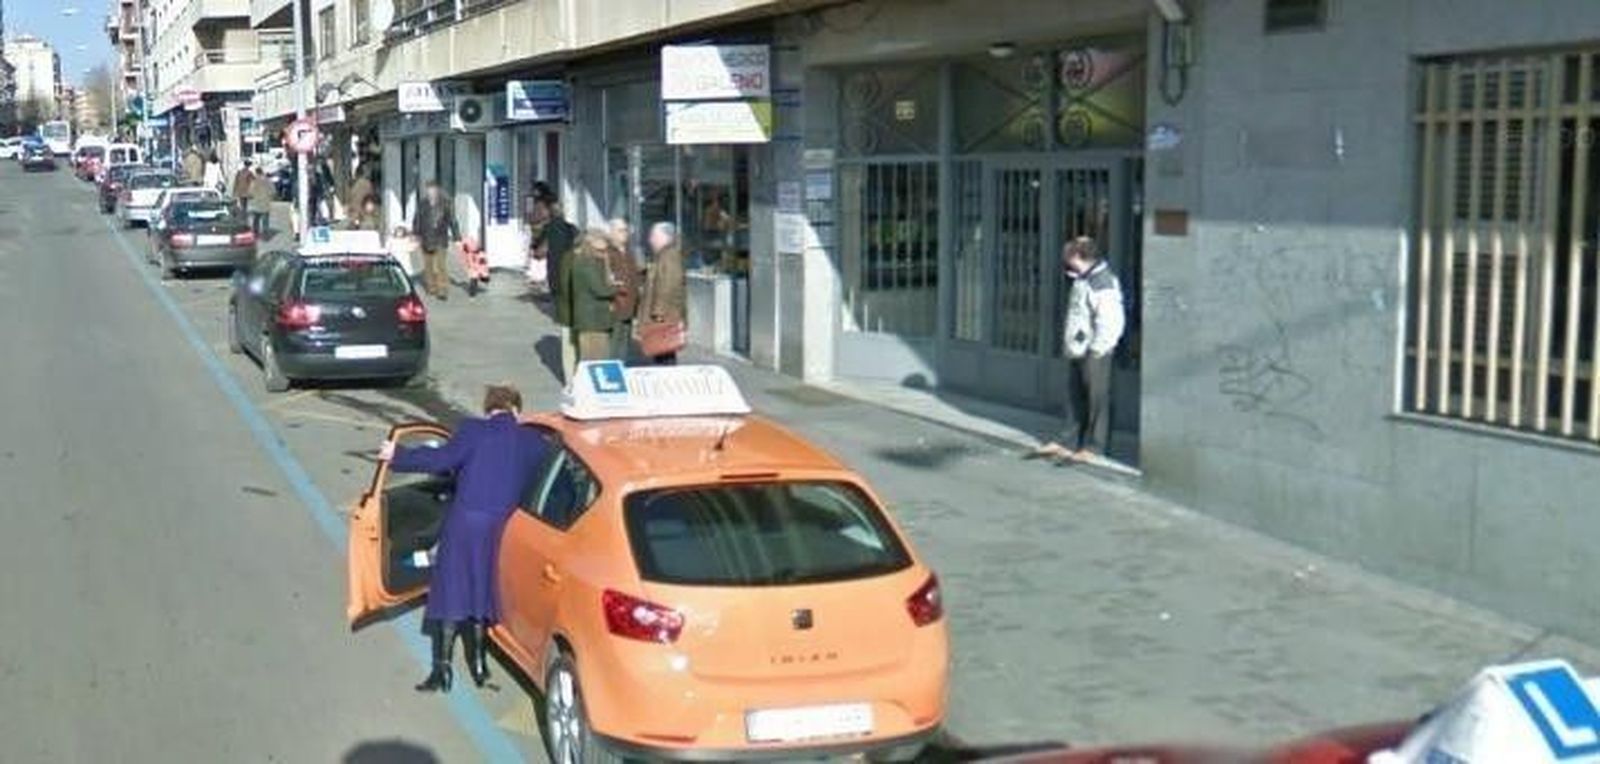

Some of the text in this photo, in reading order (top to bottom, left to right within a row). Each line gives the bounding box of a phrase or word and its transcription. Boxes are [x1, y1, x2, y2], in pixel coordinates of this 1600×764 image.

[314, 227, 328, 241] L
[594, 365, 621, 390] L
[1523, 680, 1599, 748] L
